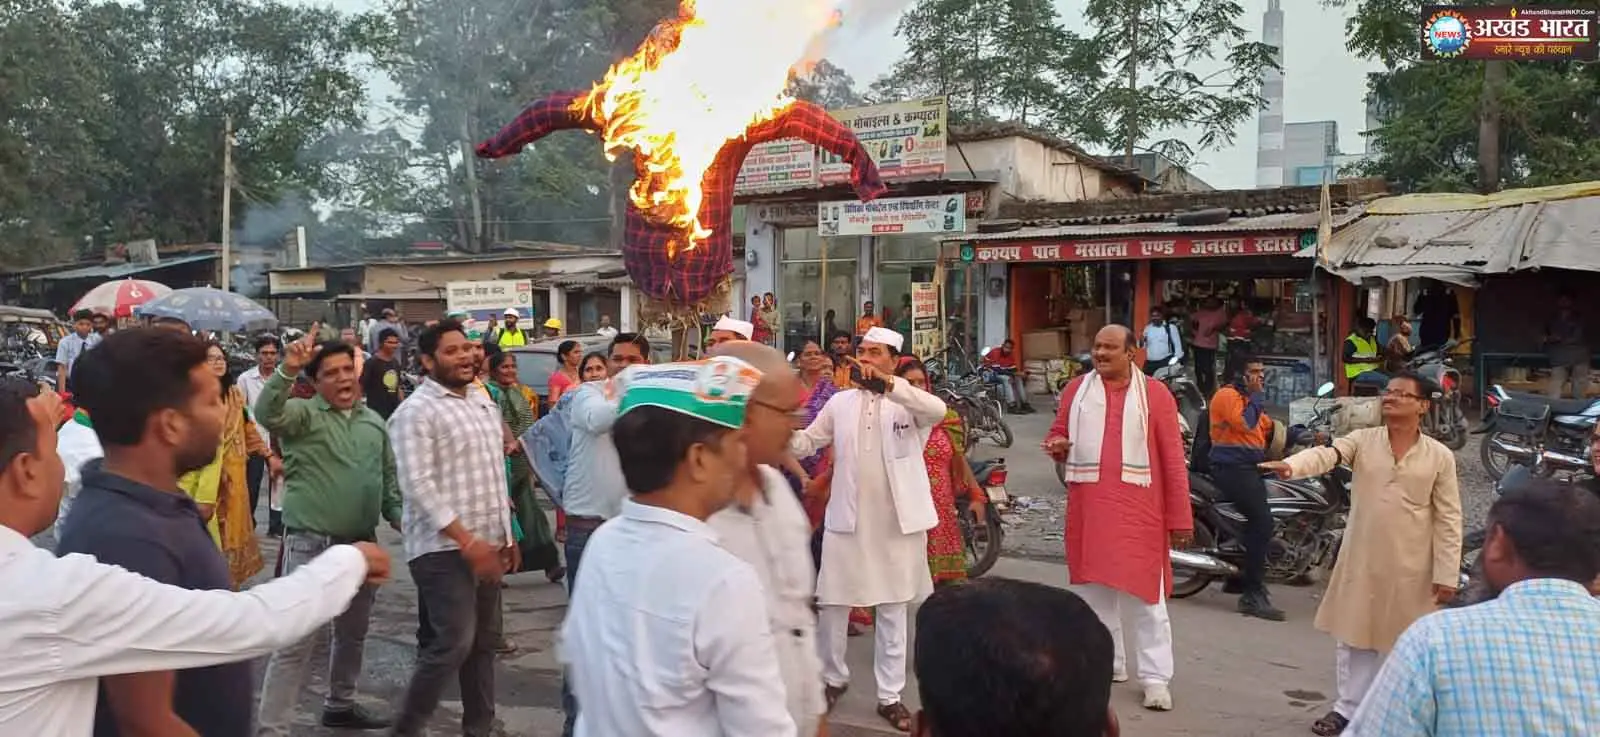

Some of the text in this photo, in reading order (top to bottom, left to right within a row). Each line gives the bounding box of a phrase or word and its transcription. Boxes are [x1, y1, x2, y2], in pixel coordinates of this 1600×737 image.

[976, 246, 1022, 260] कश्यप
[1032, 245, 1060, 259] पान
[1074, 242, 1128, 258] मसाला
[1140, 240, 1176, 255] एण्ड
[1191, 238, 1245, 254] जनरल
